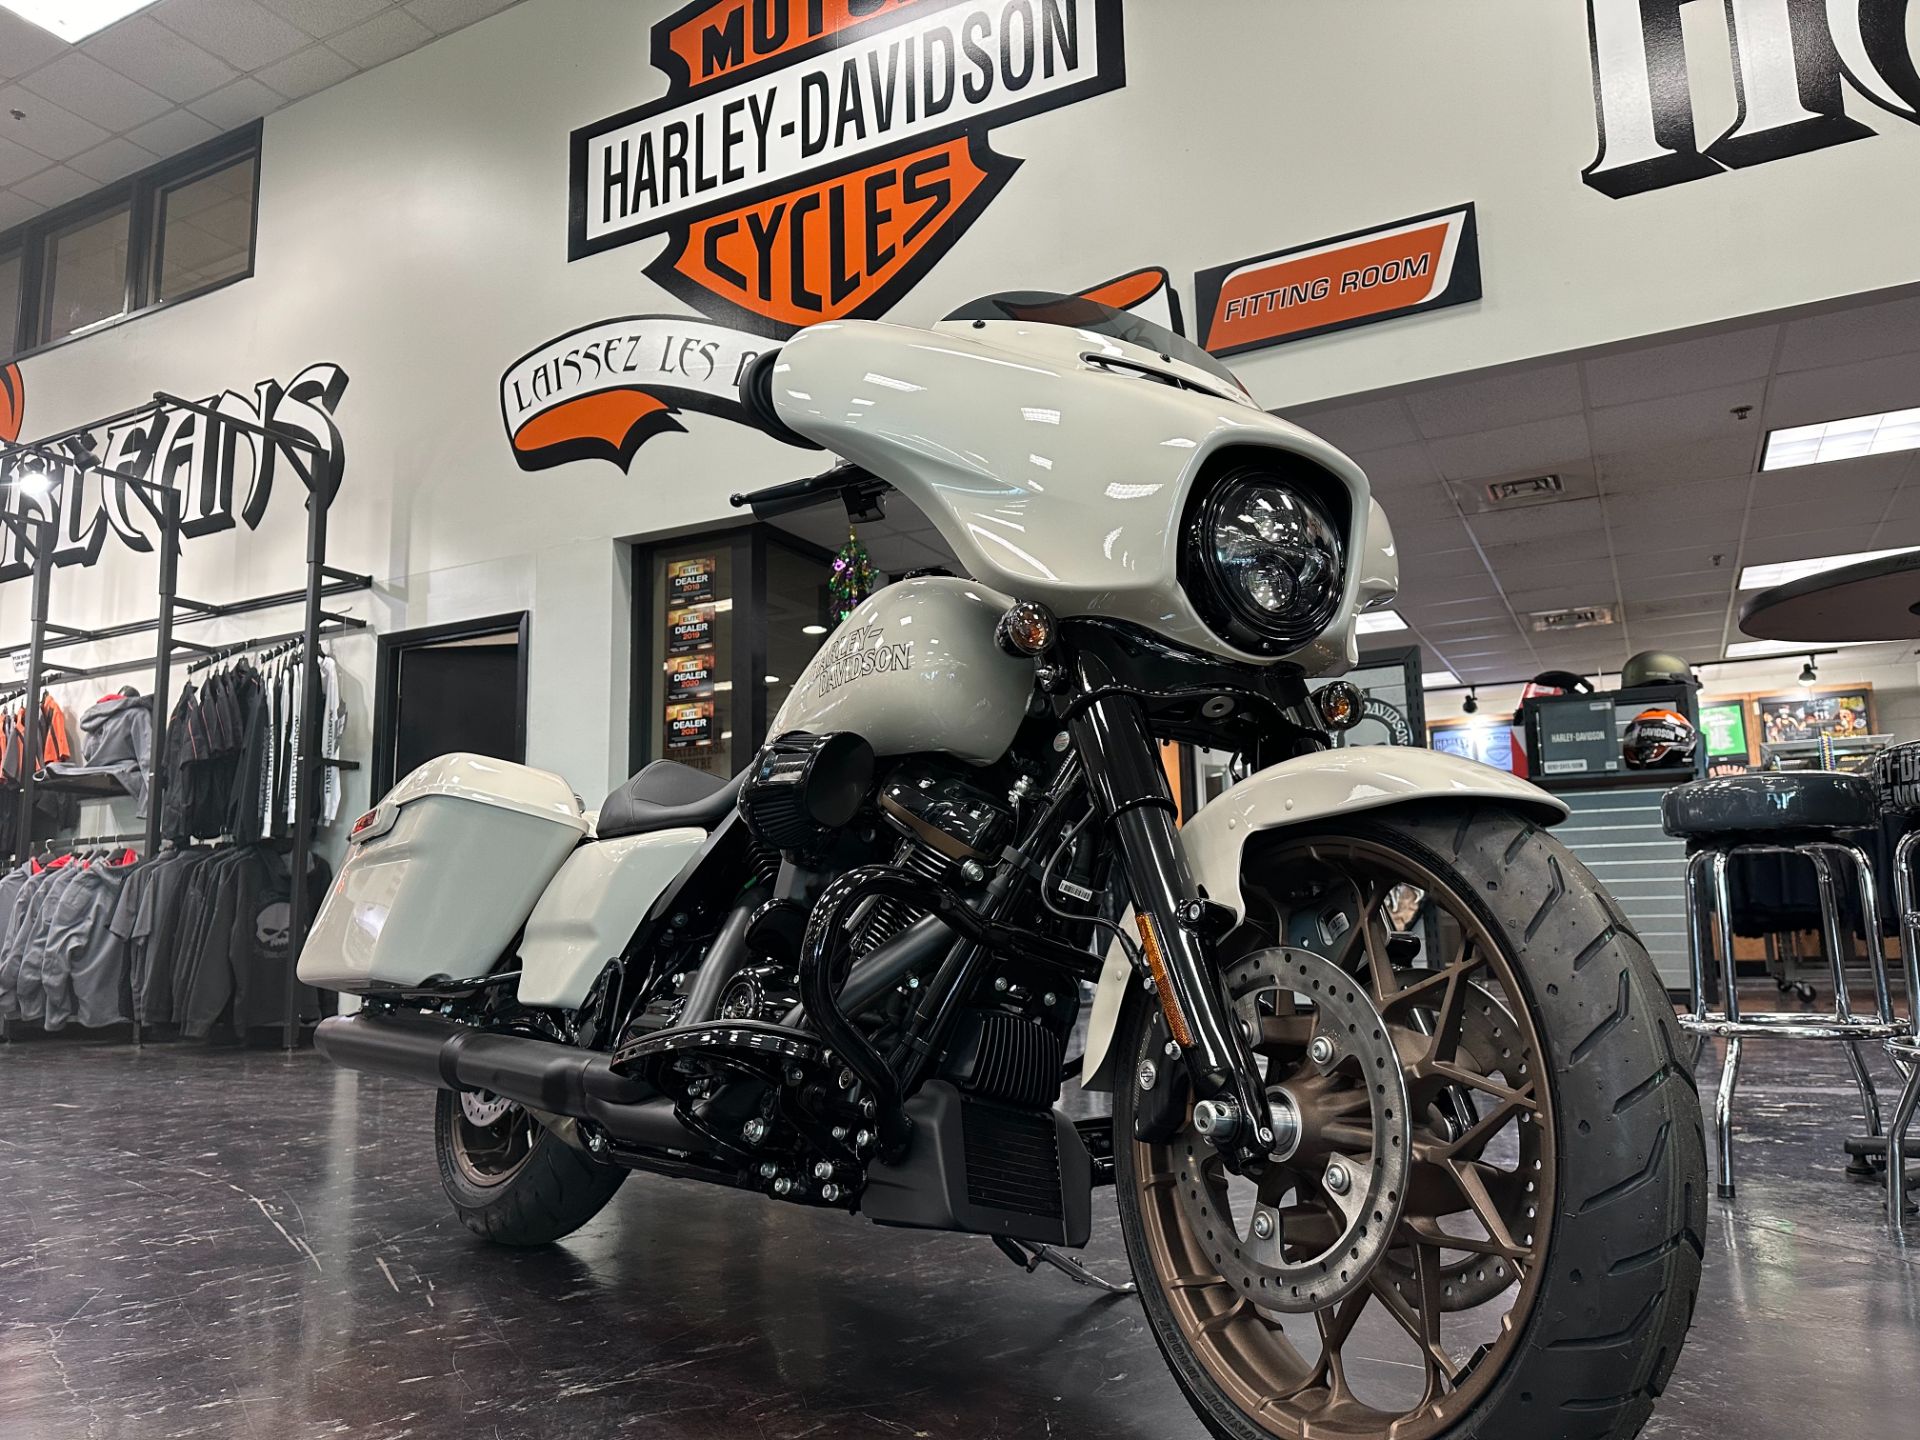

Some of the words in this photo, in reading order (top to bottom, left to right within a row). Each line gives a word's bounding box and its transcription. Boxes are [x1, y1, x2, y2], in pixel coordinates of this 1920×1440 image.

[602, 0, 1079, 223] HARLEY-DAVIDSON
[703, 152, 951, 312] CYCLES
[1224, 278, 1331, 322] FITTING
[1339, 252, 1431, 295] ROOM
[513, 335, 642, 412] LAISSEZ
[659, 336, 720, 381] LES
[675, 574, 708, 586] DEALER
[675, 623, 708, 634] DEALER
[674, 671, 707, 682] DEALER
[819, 643, 910, 698] DAVIDSON
[673, 719, 707, 730] DEALER
[1551, 730, 1605, 743] HARLEY-DAVIDSON
